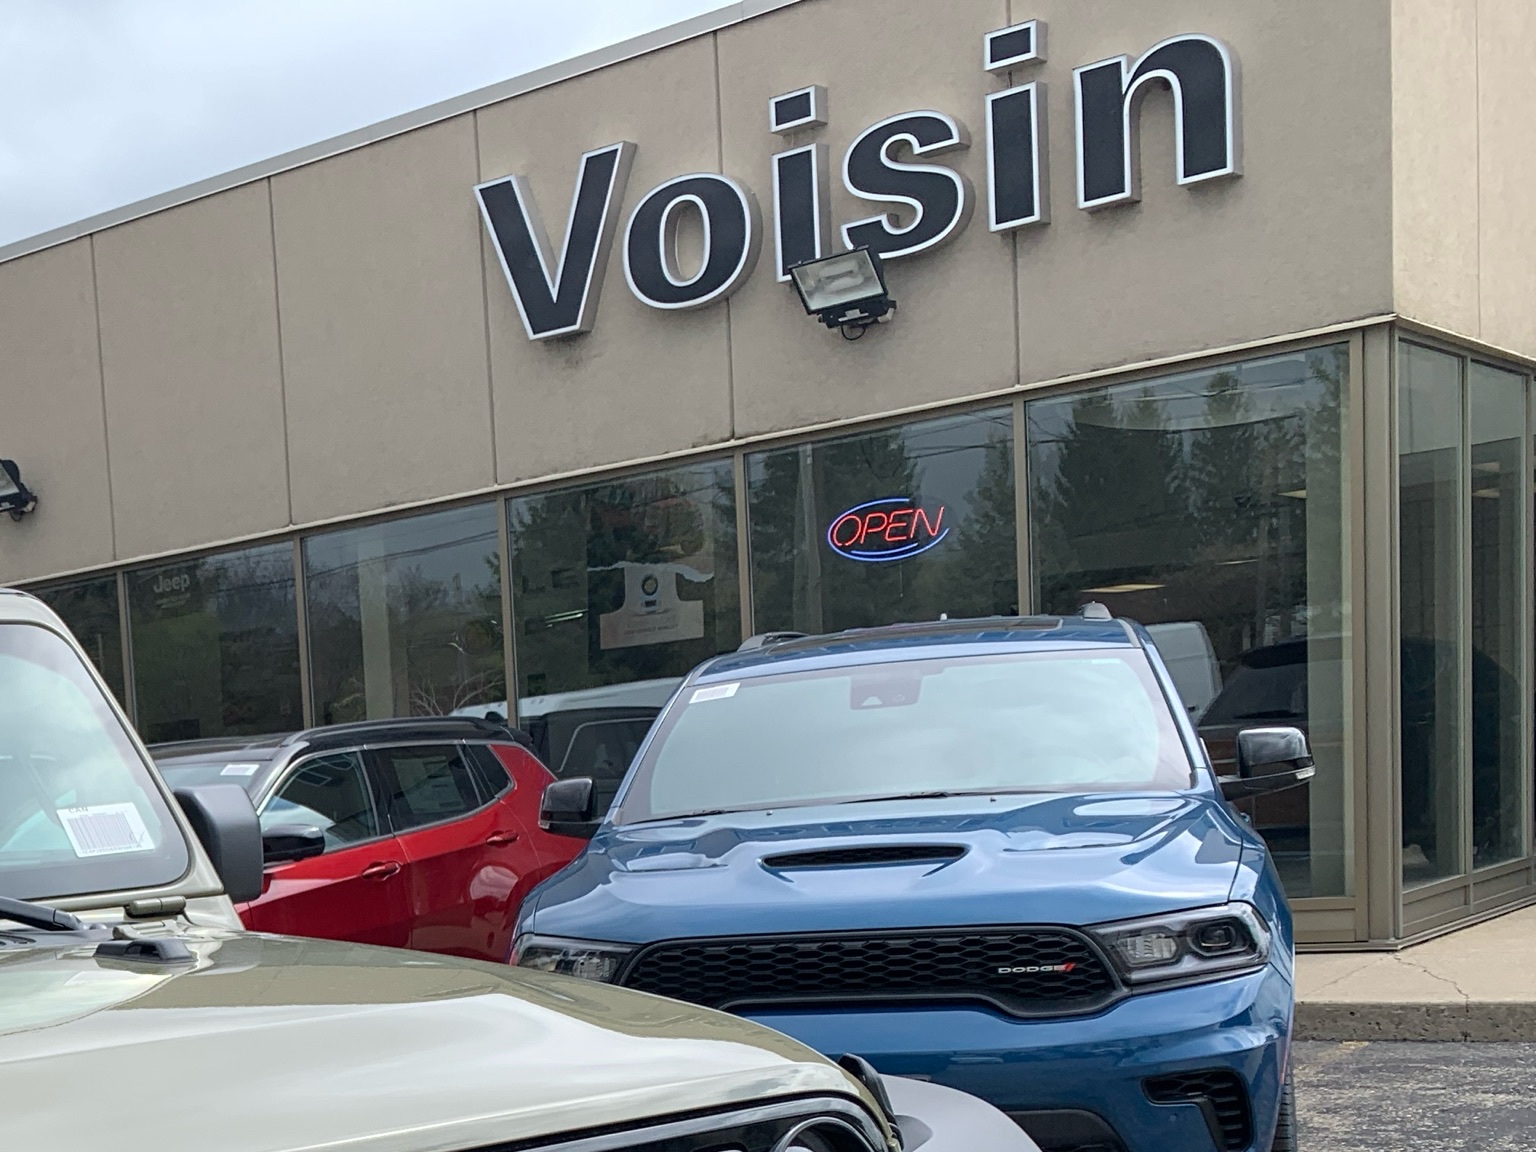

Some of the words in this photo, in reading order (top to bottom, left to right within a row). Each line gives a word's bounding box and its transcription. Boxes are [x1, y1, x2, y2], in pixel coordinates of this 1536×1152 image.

[473, 20, 1240, 341] Voisin
[832, 505, 945, 547] OPEN
[152, 573, 191, 594] Jeep
[997, 963, 1067, 974] DODGE
